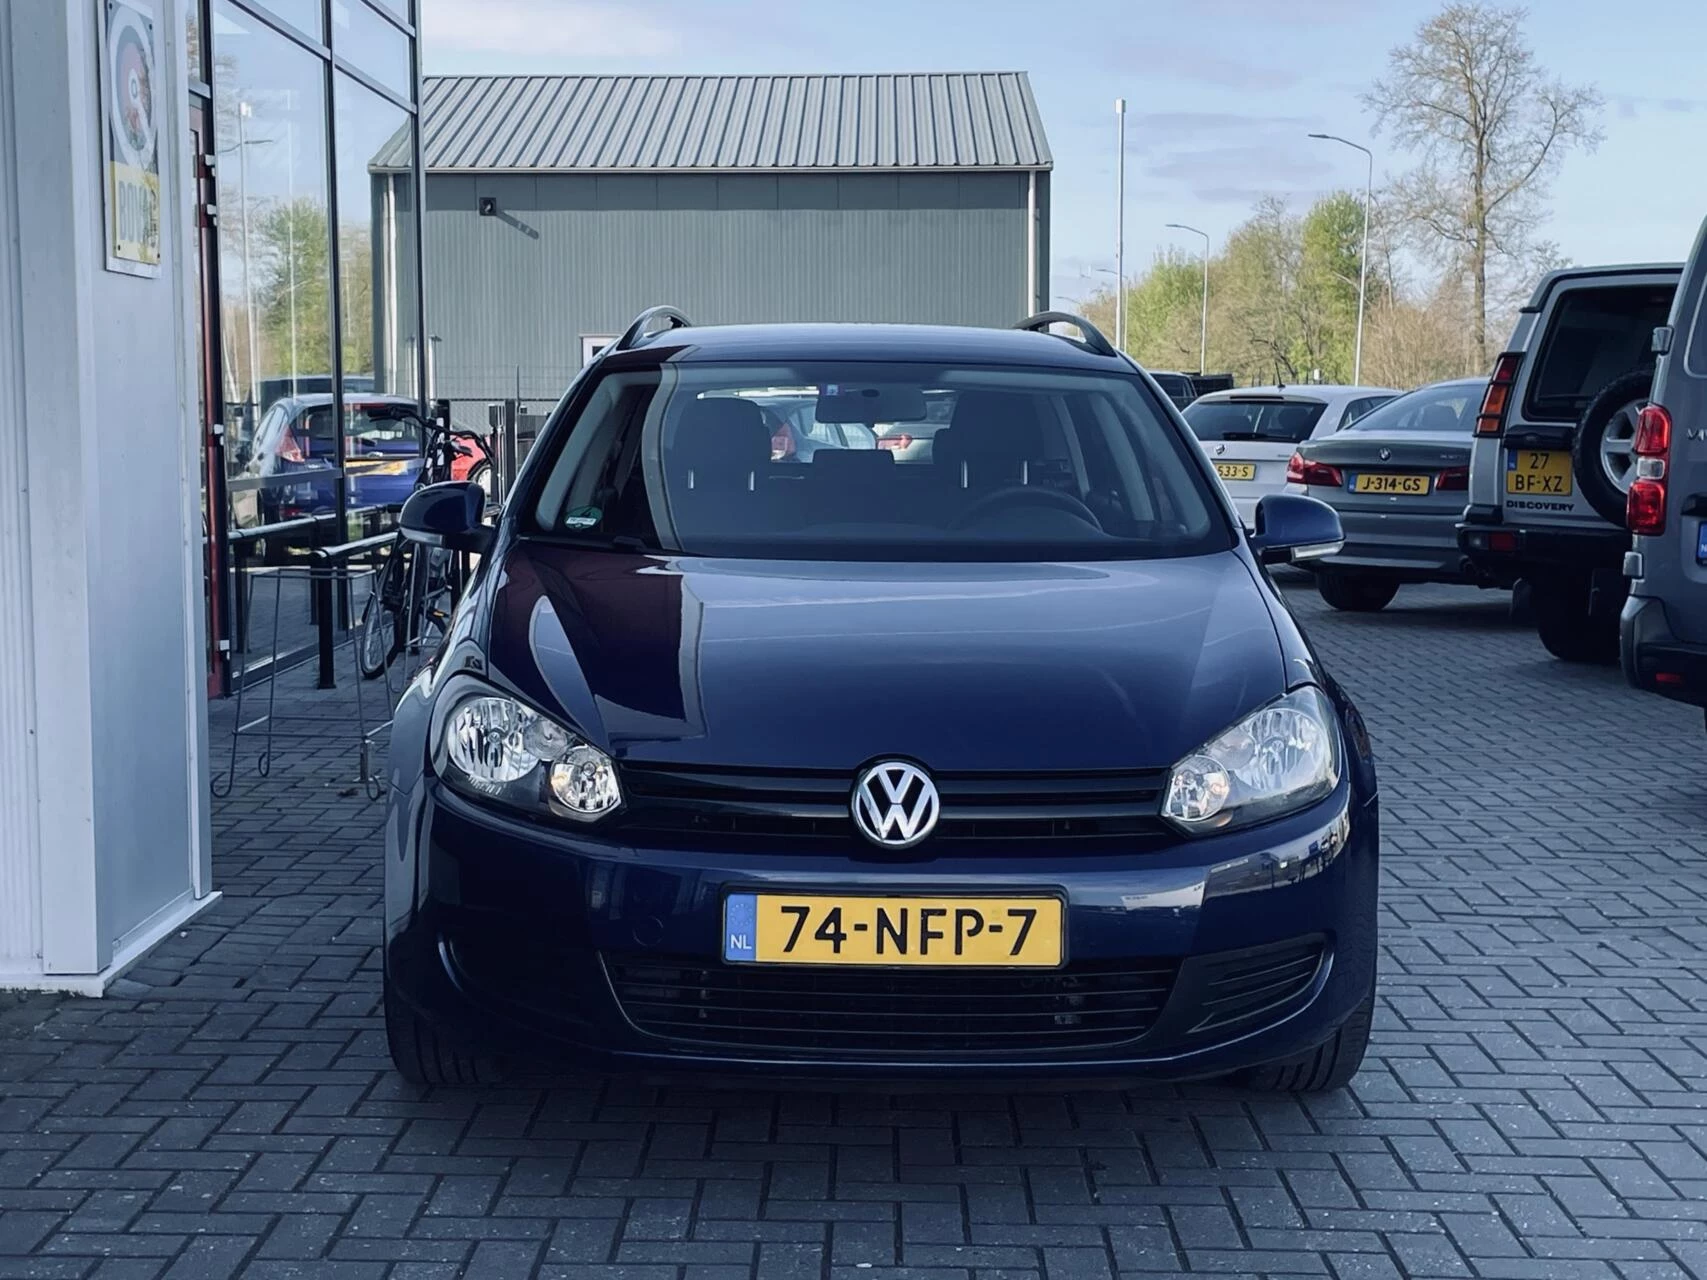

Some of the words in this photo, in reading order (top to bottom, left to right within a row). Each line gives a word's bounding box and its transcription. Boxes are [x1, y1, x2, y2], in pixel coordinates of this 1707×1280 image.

[1530, 453, 1550, 470] 27
[1362, 477, 1421, 491] J-314-GS
[1515, 474, 1563, 492] BF-XZ
[1506, 500, 1575, 511] DISCOVERY
[780, 905, 1037, 956] 74-NFP-7
[730, 934, 752, 950] NL
